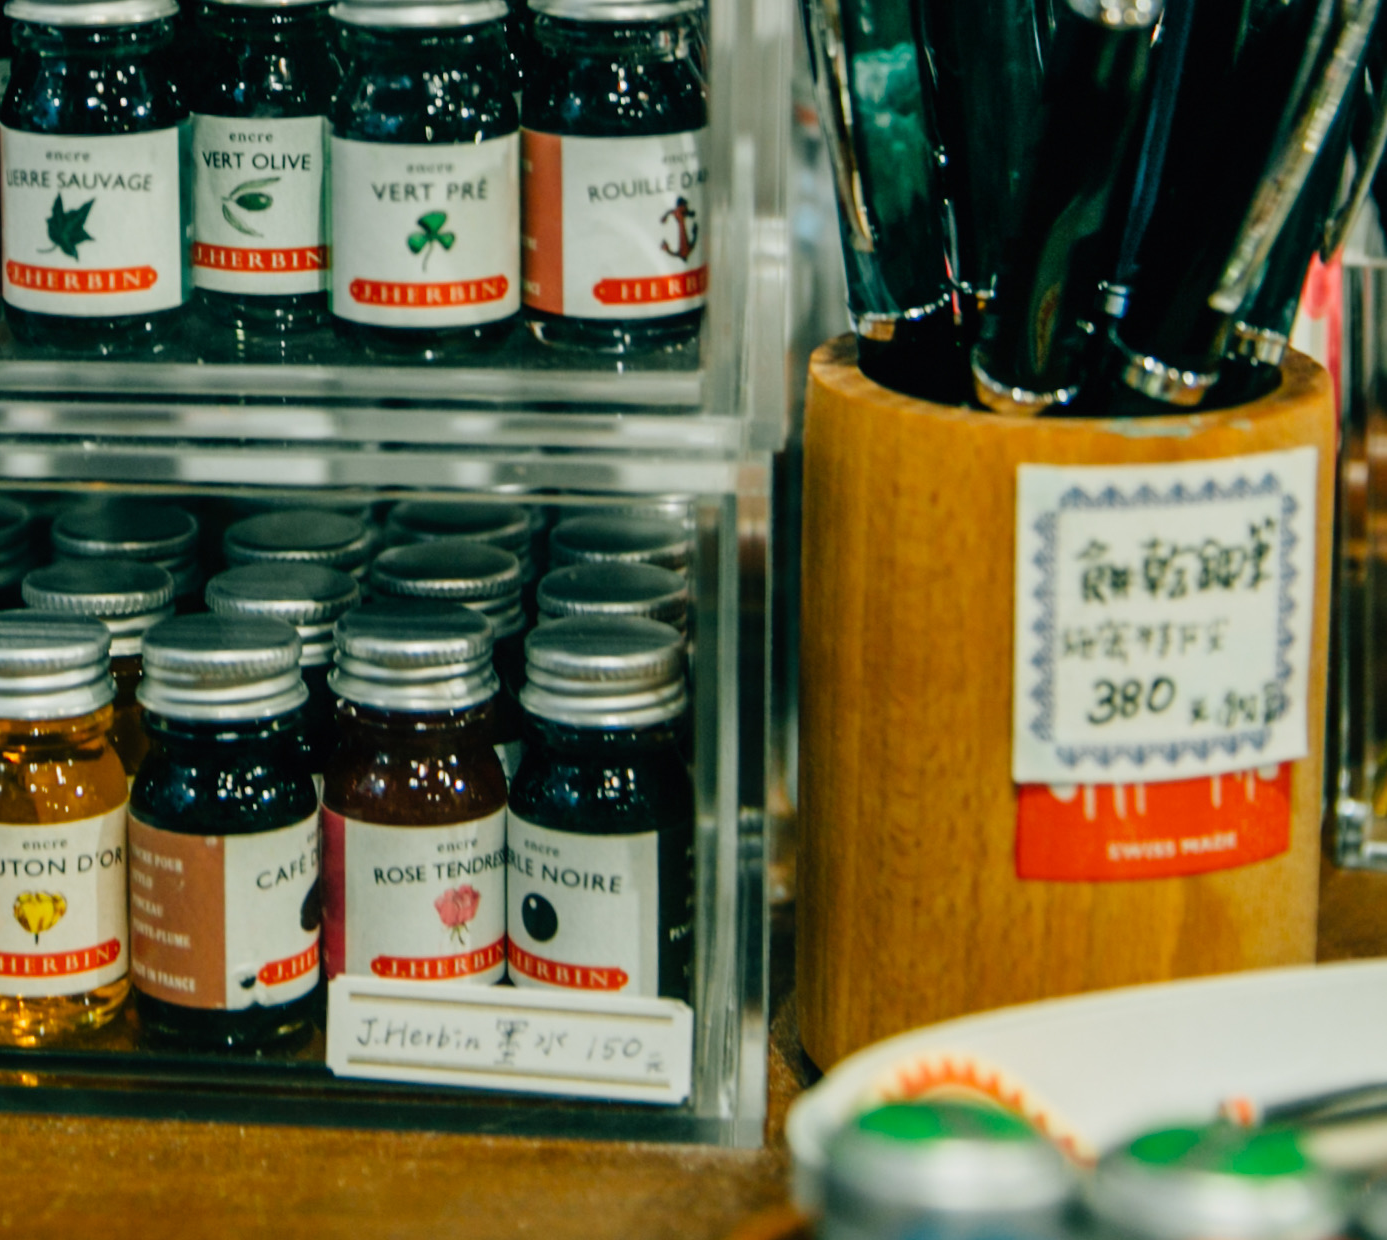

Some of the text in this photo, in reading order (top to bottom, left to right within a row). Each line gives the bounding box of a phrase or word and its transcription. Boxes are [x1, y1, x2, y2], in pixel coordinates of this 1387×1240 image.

[228, 131, 274, 144] encre
[45, 150, 91, 163] encre
[201, 151, 313, 173] VERT OLIVE
[406, 162, 455, 175] encre
[56, 171, 154, 193] SAUVAGE
[371, 178, 489, 203] VERT PRÉ
[587, 171, 677, 204] ROUILLE
[195, 245, 325, 270] J.HERBIN
[13, 267, 143, 291] J.HERBIN
[361, 280, 501, 305] J.HERBIN
[1087, 676, 1176, 725] 380
[21, 838, 68, 852] encre
[437, 836, 479, 854] encre
[76, 846, 124, 873] D'OR
[154, 854, 184, 873] POUR
[256, 851, 308, 891] CAFÉ
[373, 865, 426, 886] ROSE
[541, 865, 623, 895] NOIRE
[159, 970, 197, 994] FRANCE
[356, 1016, 481, 1051] J.Herbin
